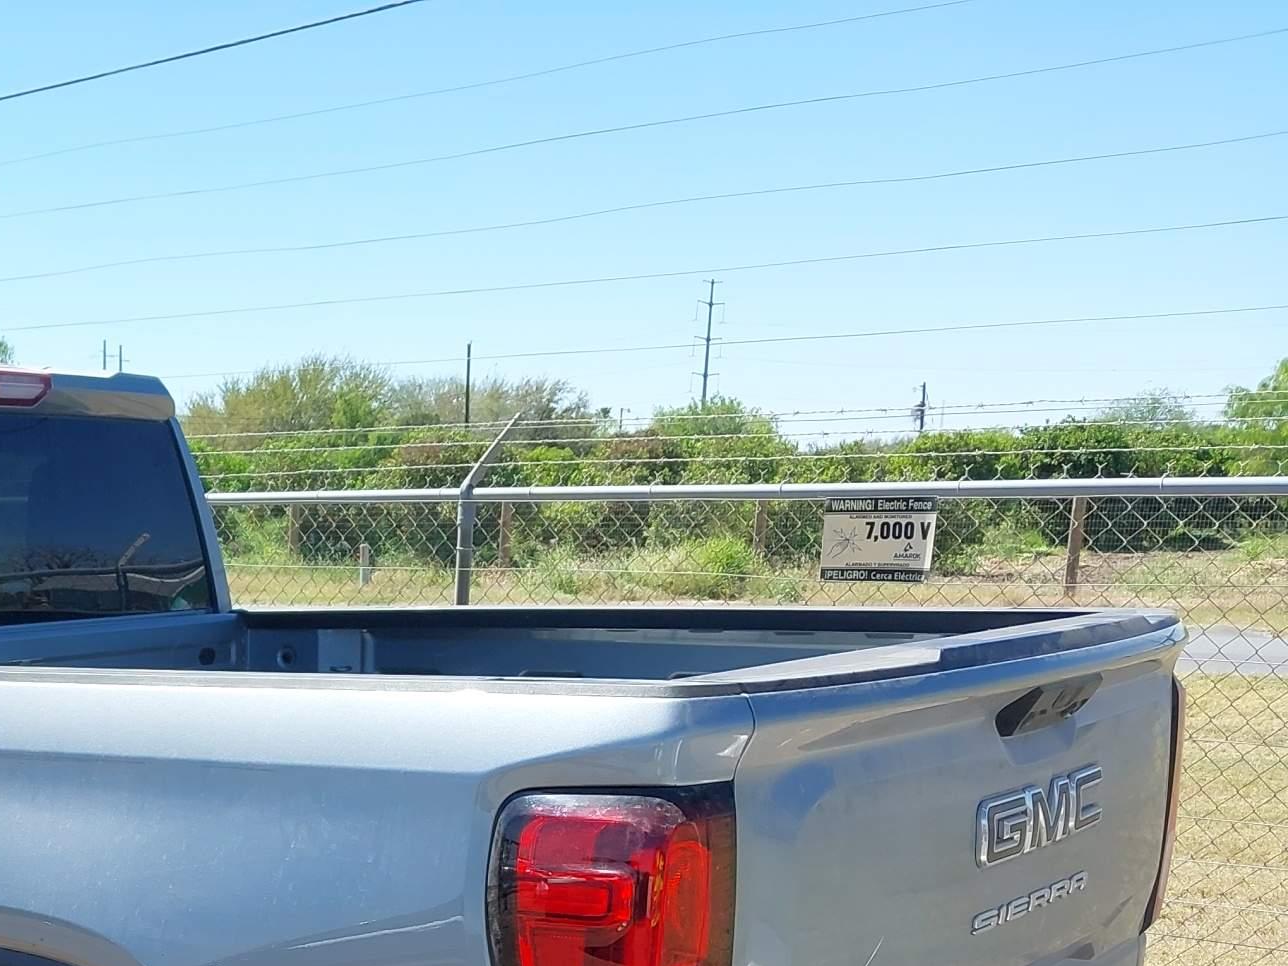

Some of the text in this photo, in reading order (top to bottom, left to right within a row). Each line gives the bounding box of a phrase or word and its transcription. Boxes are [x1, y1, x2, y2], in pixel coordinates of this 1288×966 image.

[832, 498, 932, 511] WARNING! Electric Fence
[865, 521, 931, 542] 7,000 V
[824, 570, 926, 581] ¡PELIGRO! Cerca Eléctrica
[975, 762, 1103, 870] GMC
[970, 870, 1088, 936] SIERRA
